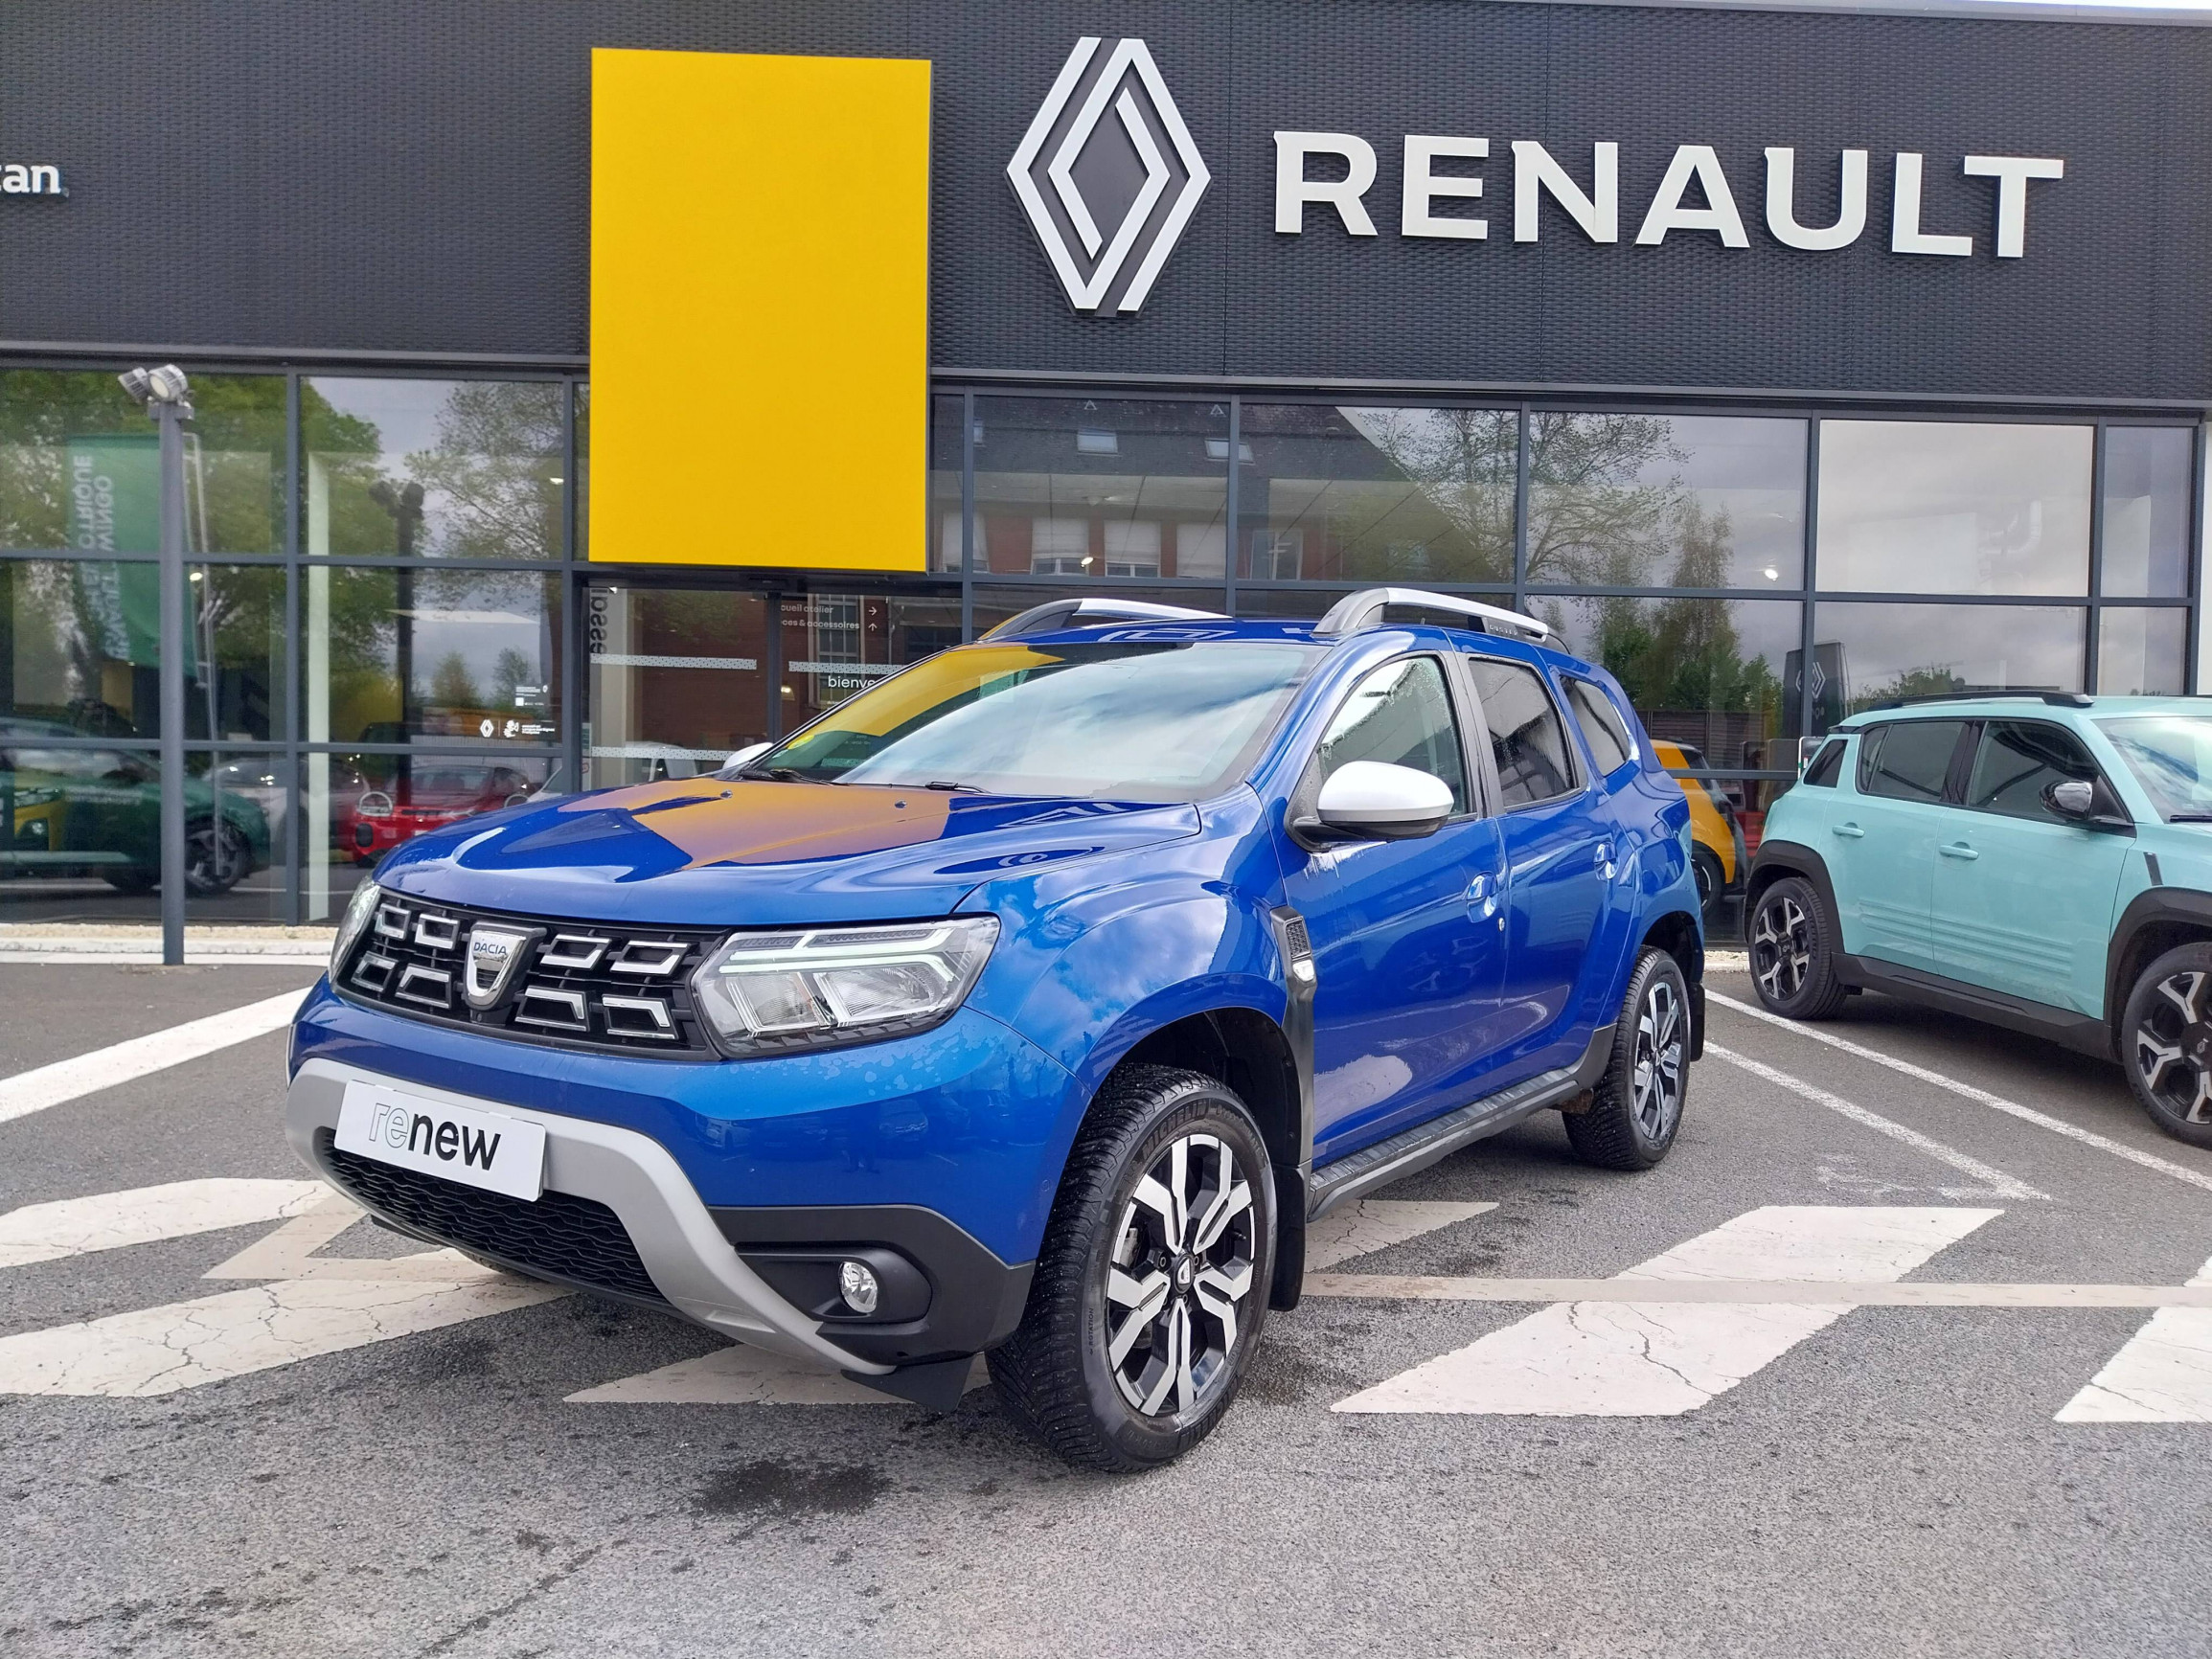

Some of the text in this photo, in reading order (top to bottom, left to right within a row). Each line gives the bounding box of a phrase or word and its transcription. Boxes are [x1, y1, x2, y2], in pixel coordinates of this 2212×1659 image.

[0, 164, 61, 194] an
[1273, 130, 2065, 259] RENAULT
[780, 604, 803, 613] cueil
[807, 621, 860, 629] accessoires
[828, 675, 876, 689] bienve
[473, 942, 507, 956] DACIA
[368, 1102, 501, 1171] renew
